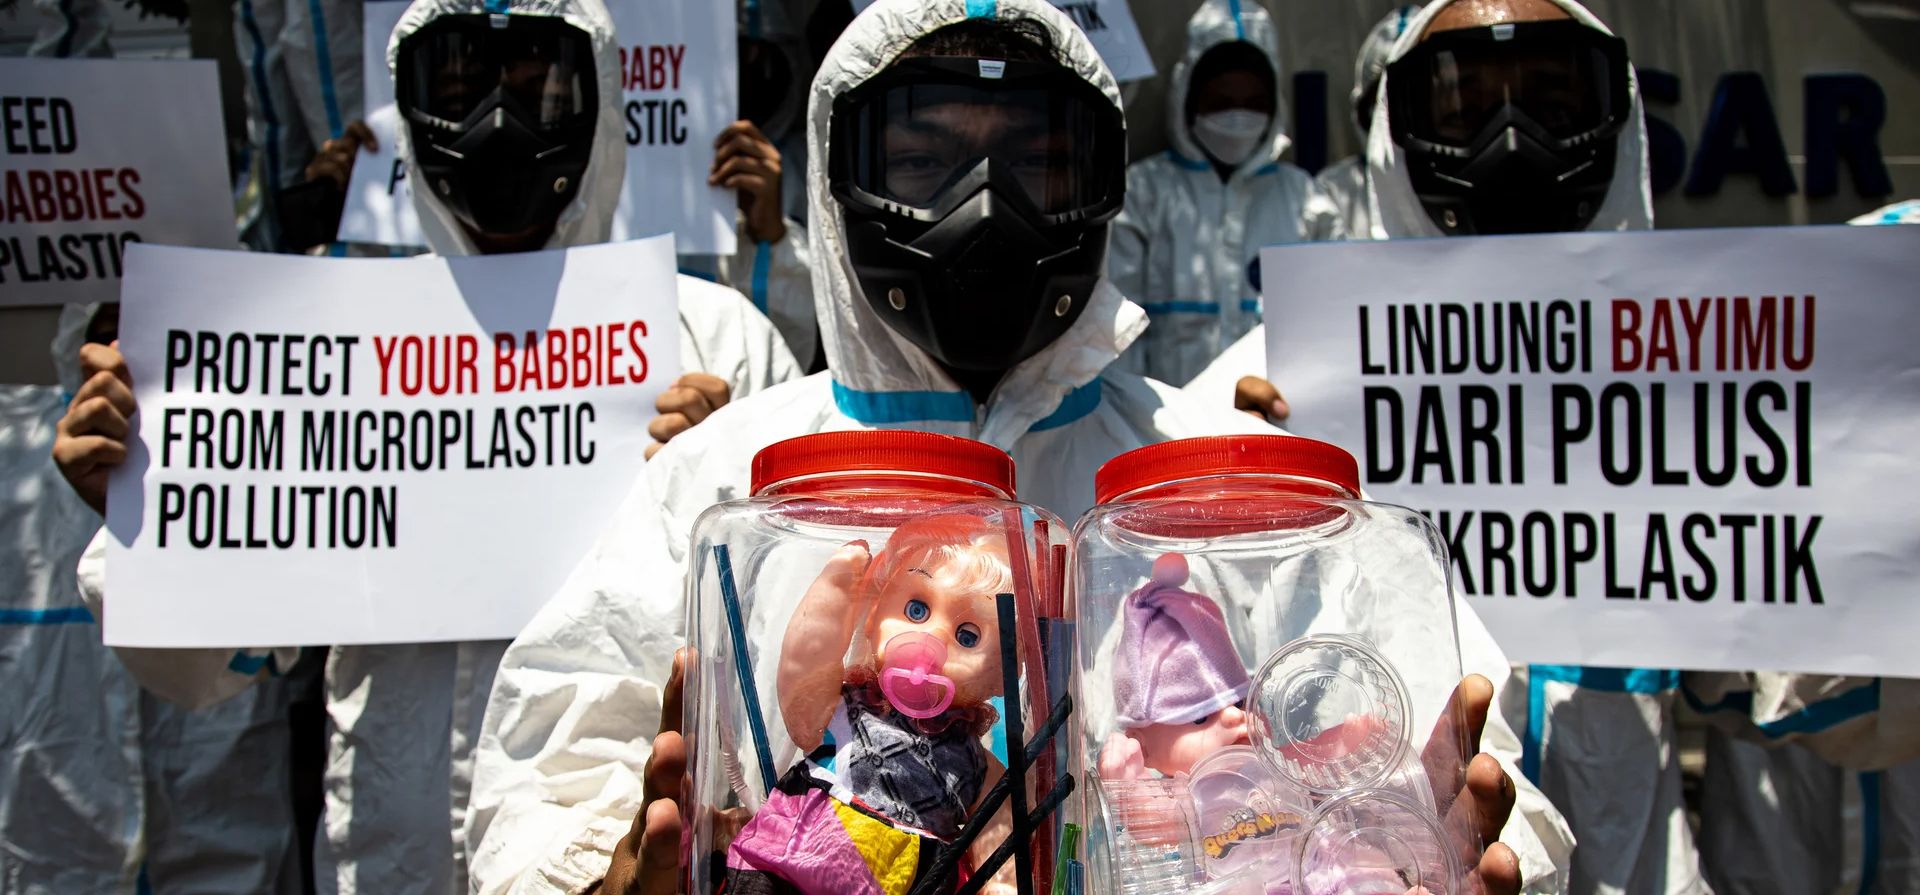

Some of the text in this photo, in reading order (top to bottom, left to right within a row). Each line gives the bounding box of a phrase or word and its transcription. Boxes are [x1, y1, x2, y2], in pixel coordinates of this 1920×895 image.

[0, 97, 77, 154] EED
[625, 98, 687, 146] STIC
[0, 167, 146, 224] ABBIES
[0, 231, 141, 284] PLASTI
[165, 320, 648, 396] PROTECT YOUR BABBIES
[1359, 296, 1817, 376] LINDUNGI BAYIMU
[162, 402, 595, 472] FROM MICROPLASTIC
[1363, 380, 1813, 488] DARI POLUSI
[158, 482, 397, 549] POLLUTION
[1420, 510, 1826, 604] KROPLASTIK
